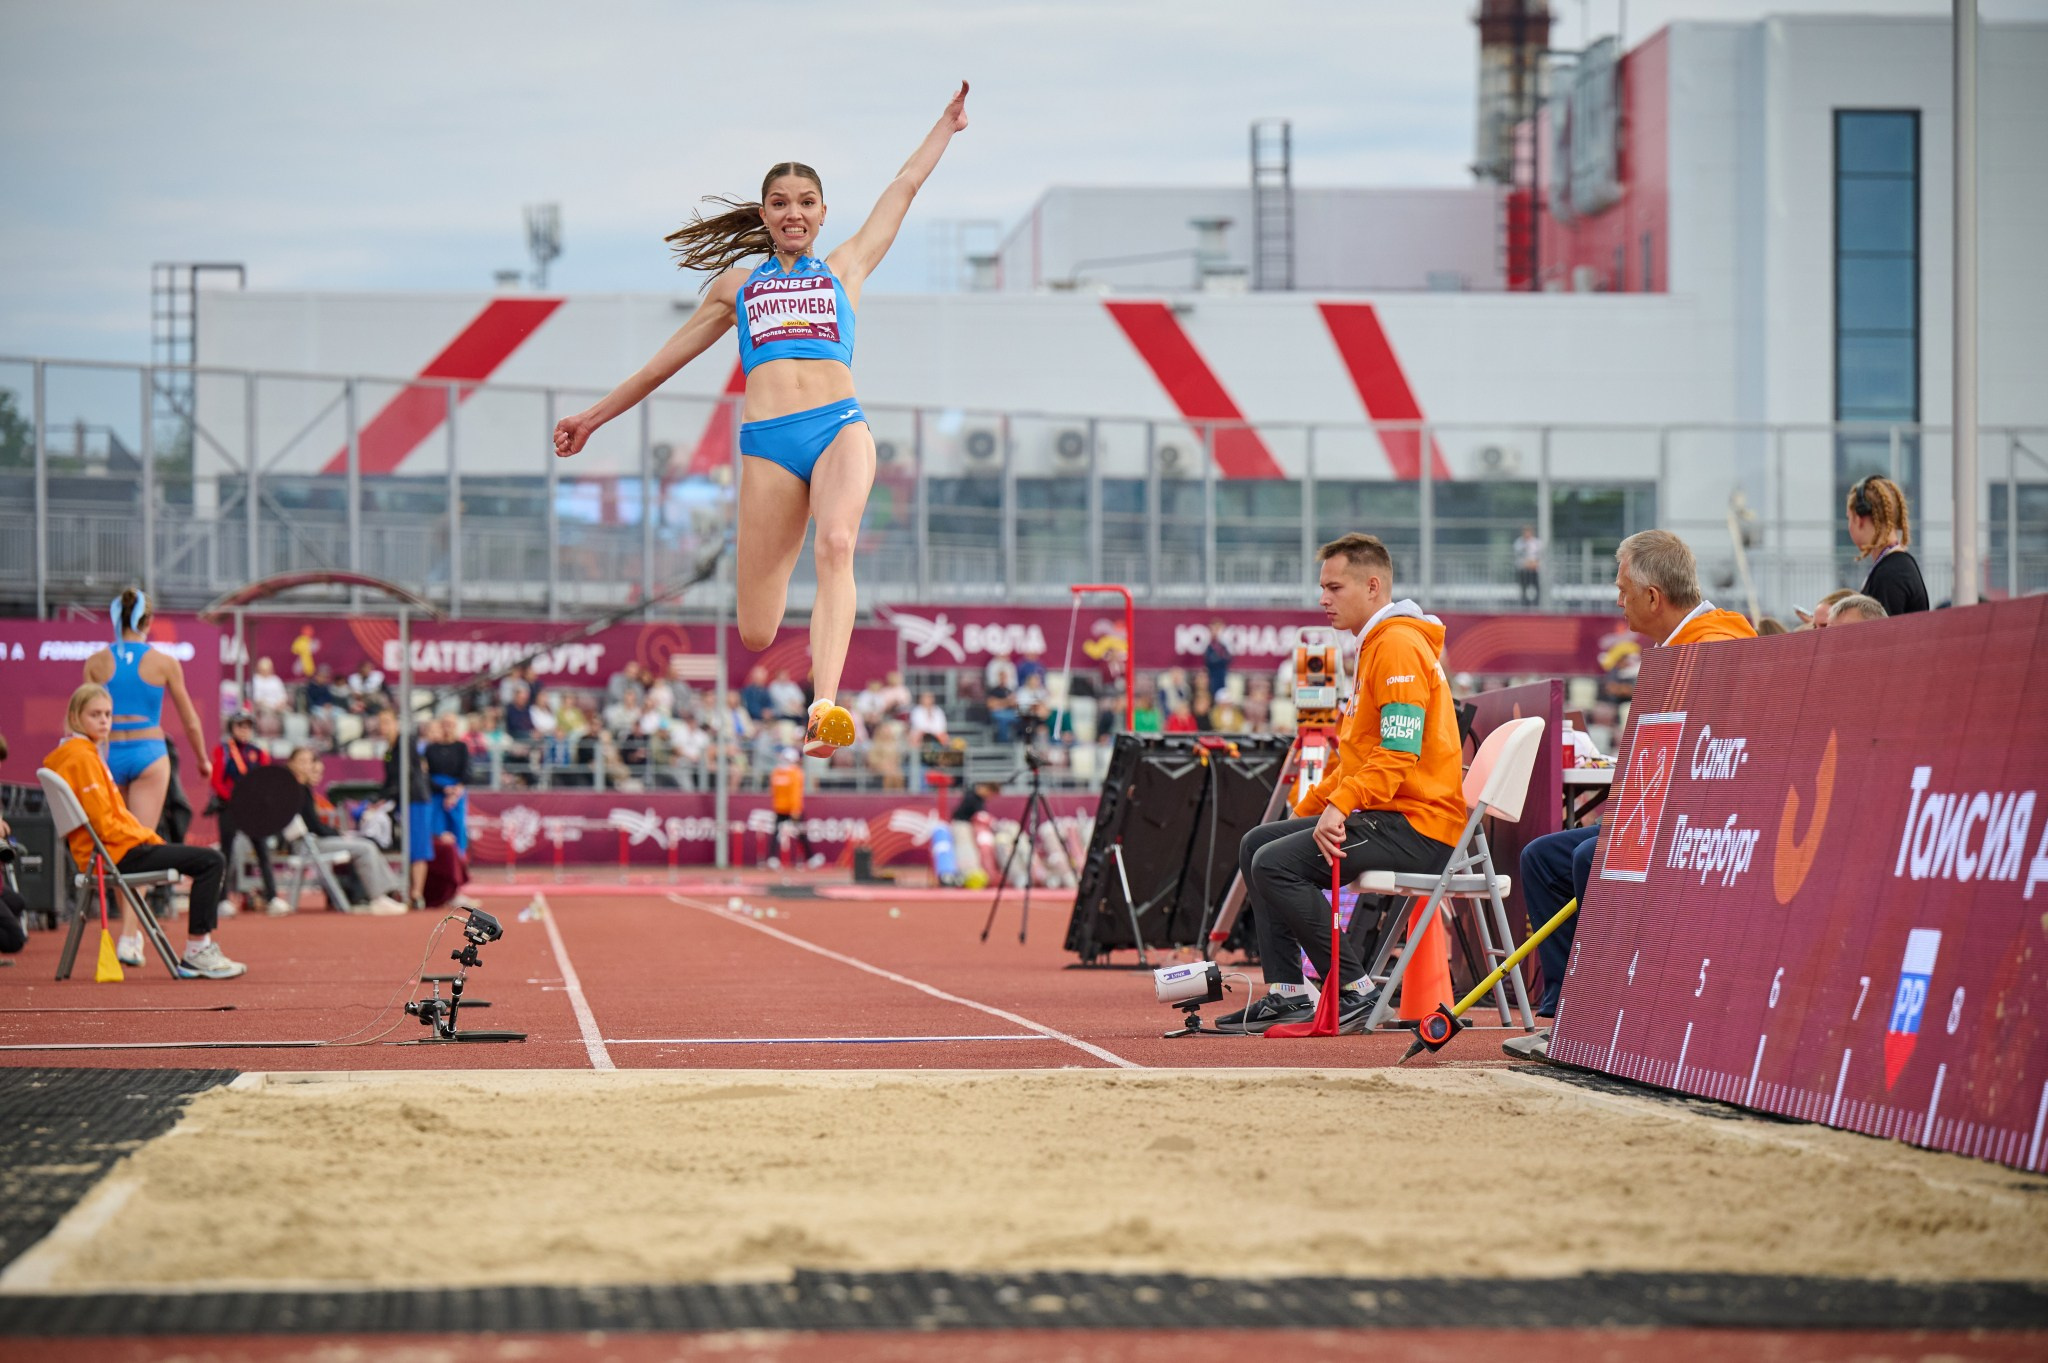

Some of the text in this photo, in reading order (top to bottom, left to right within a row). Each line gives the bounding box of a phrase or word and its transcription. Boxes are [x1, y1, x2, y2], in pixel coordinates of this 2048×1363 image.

[748, 297, 836, 325] ДМИТРИЕВА
[752, 276, 824, 293] FONBET
[1385, 674, 1416, 686] FONBET
[1690, 724, 1749, 780] Санкт-
[1666, 813, 1760, 888] Петербург
[1893, 765, 2038, 883] Таисия
[1569, 941, 1966, 1035] 3 4 5 6 7 8
